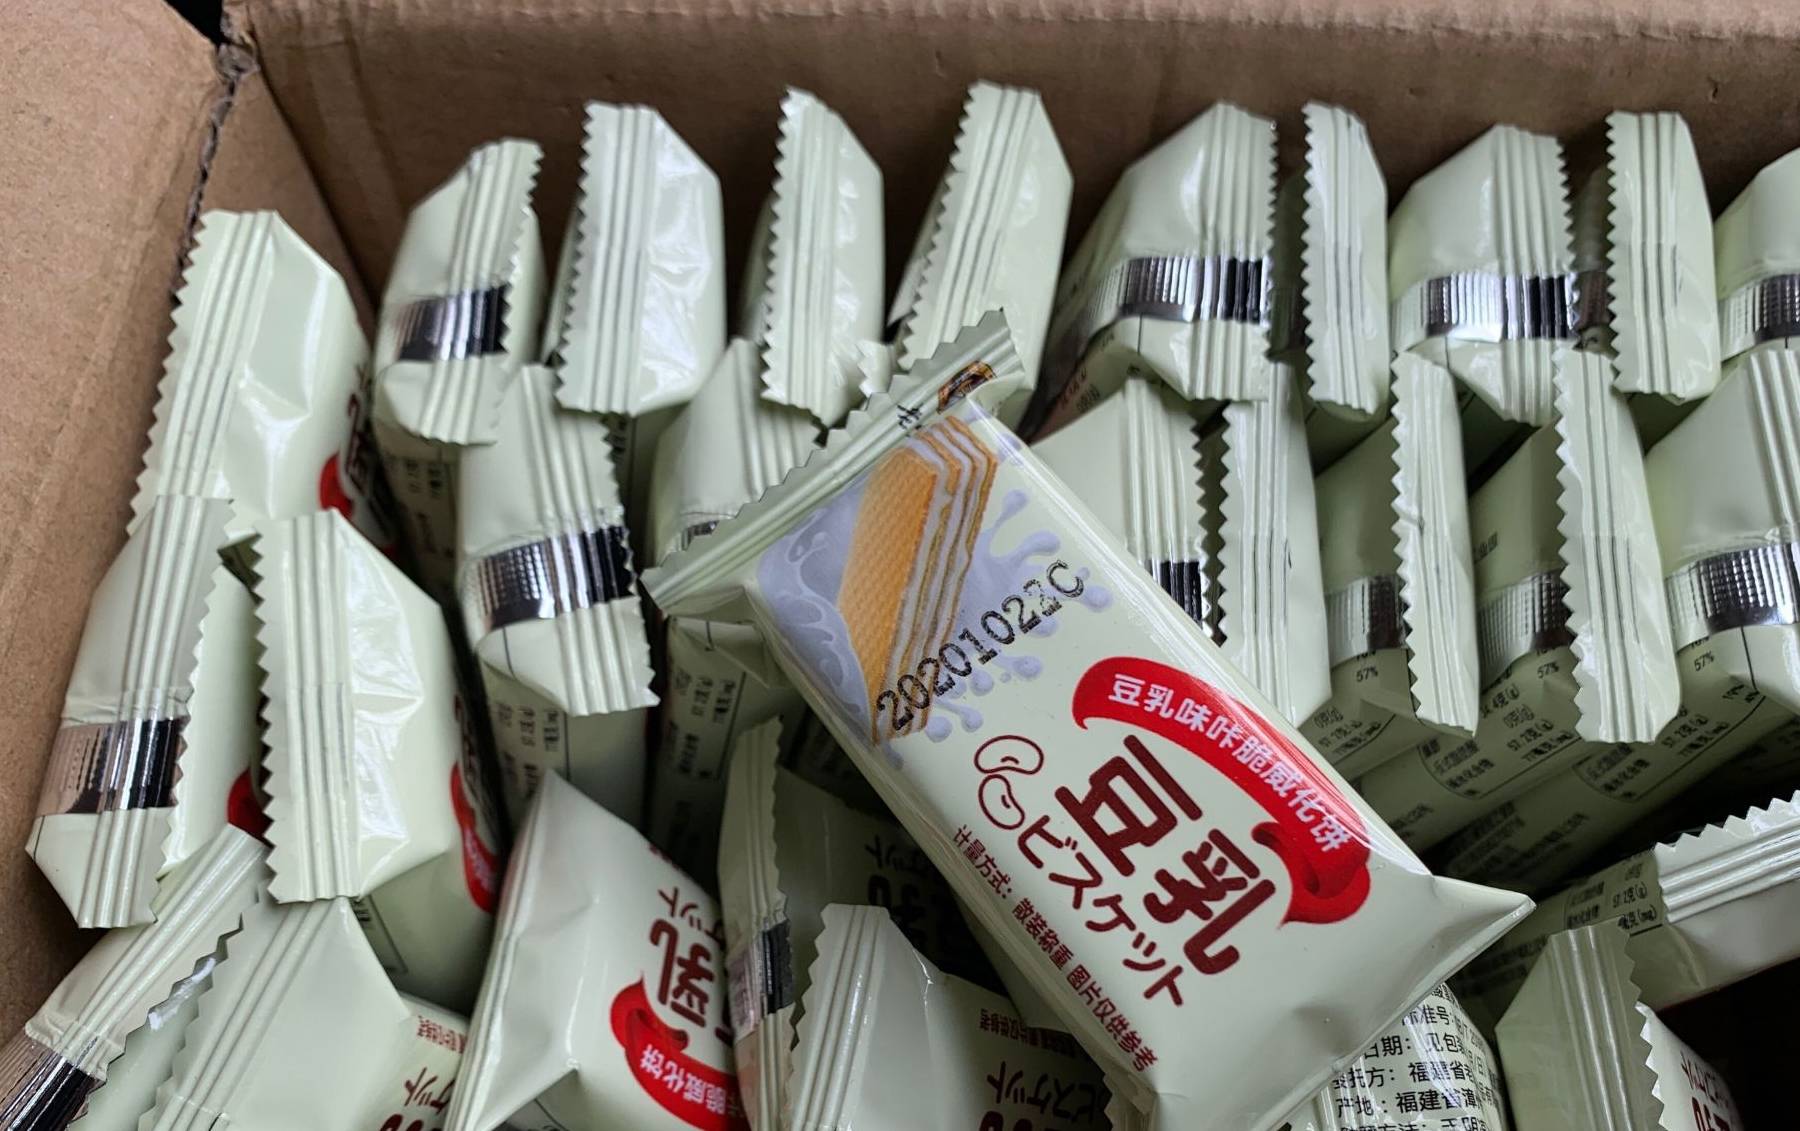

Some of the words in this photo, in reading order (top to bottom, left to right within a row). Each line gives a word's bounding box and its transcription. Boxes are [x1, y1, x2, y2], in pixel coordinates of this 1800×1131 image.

[1108, 673, 1352, 853] 豆乳味咔脆威化饼
[1017, 814, 1184, 1007] ビスケット
[1054, 733, 1277, 976] 豆乳
[649, 918, 734, 1044] 乳
[1011, 897, 1075, 971] 散装称重
[1066, 963, 1159, 1073] 图片仅供参考
